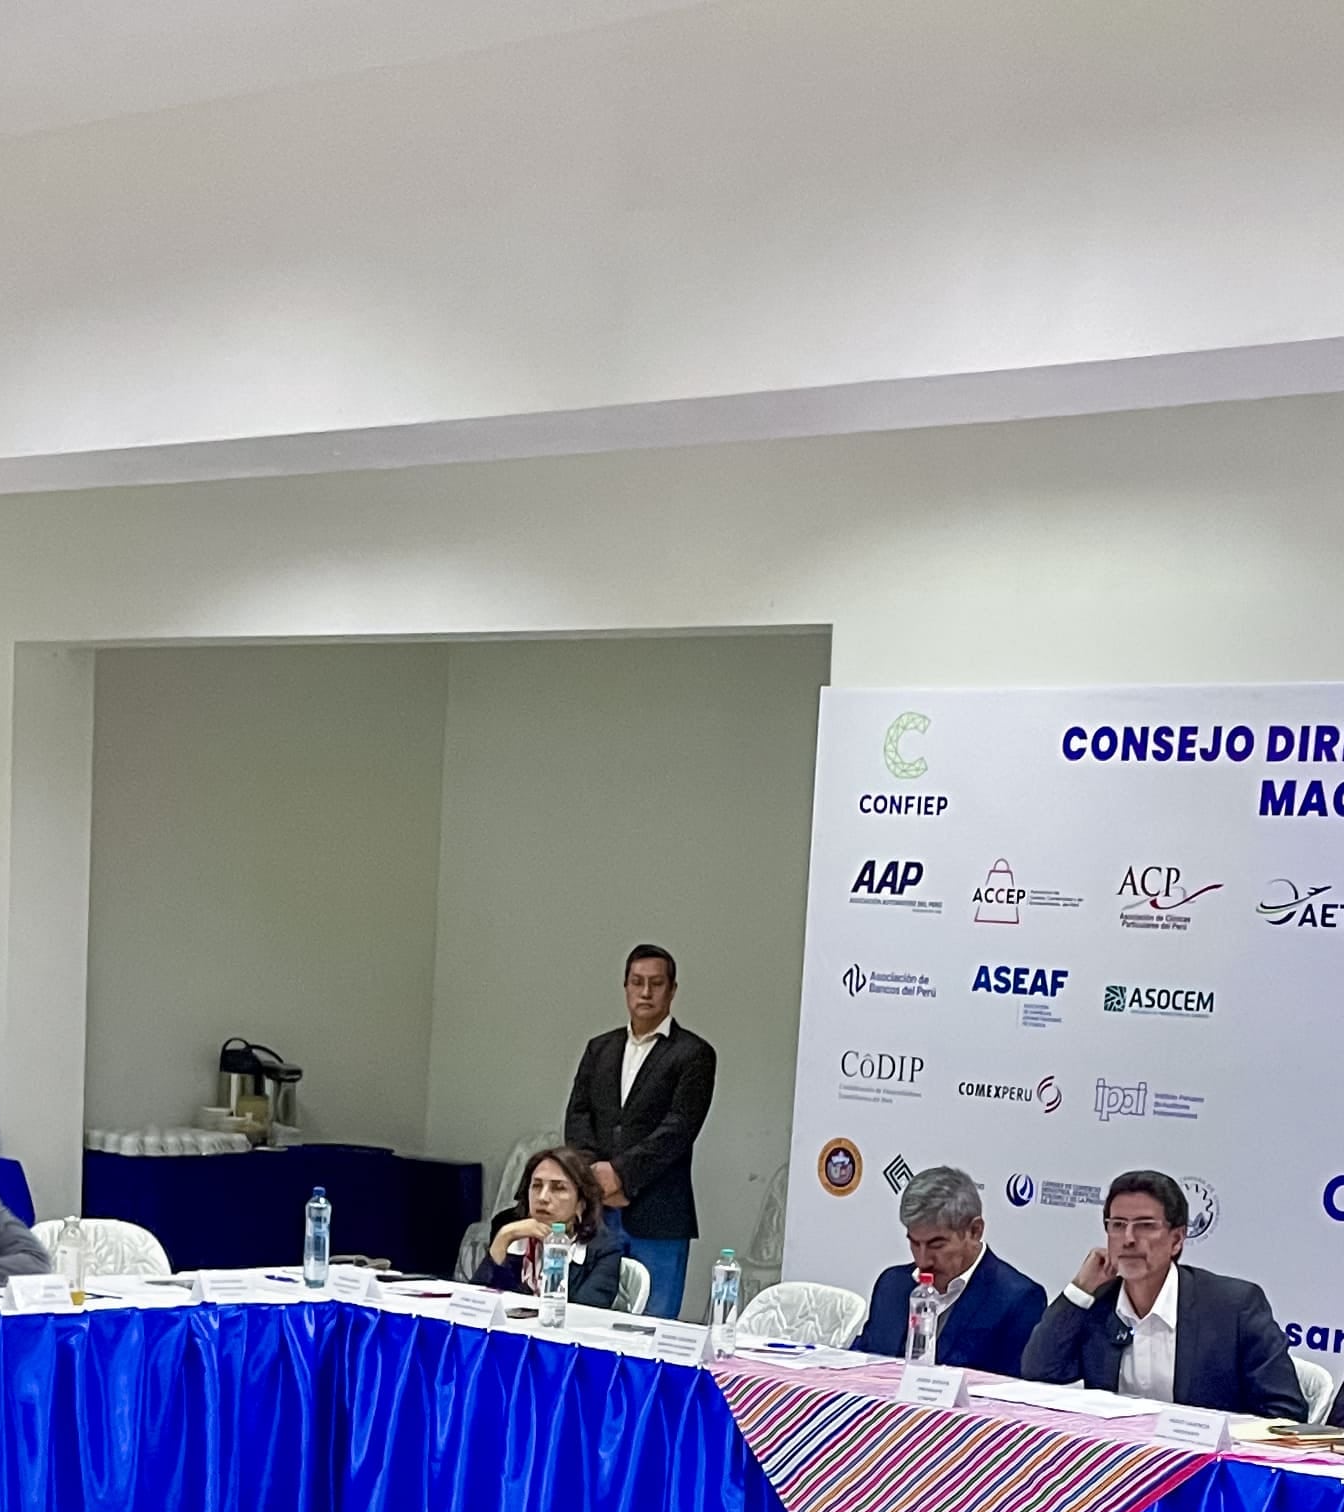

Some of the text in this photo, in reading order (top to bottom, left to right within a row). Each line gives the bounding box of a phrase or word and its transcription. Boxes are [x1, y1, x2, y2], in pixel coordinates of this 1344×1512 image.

[1062, 725, 1254, 762] CONSEJO
[859, 794, 948, 816] CONFIEP
[851, 860, 924, 895] AAP
[1116, 865, 1181, 897] ACP
[972, 887, 1026, 905] ACCEP
[971, 965, 1069, 997] ASEAF
[1129, 988, 1214, 1013] ASOCEM
[958, 1082, 1032, 1102] COMEXPERU
